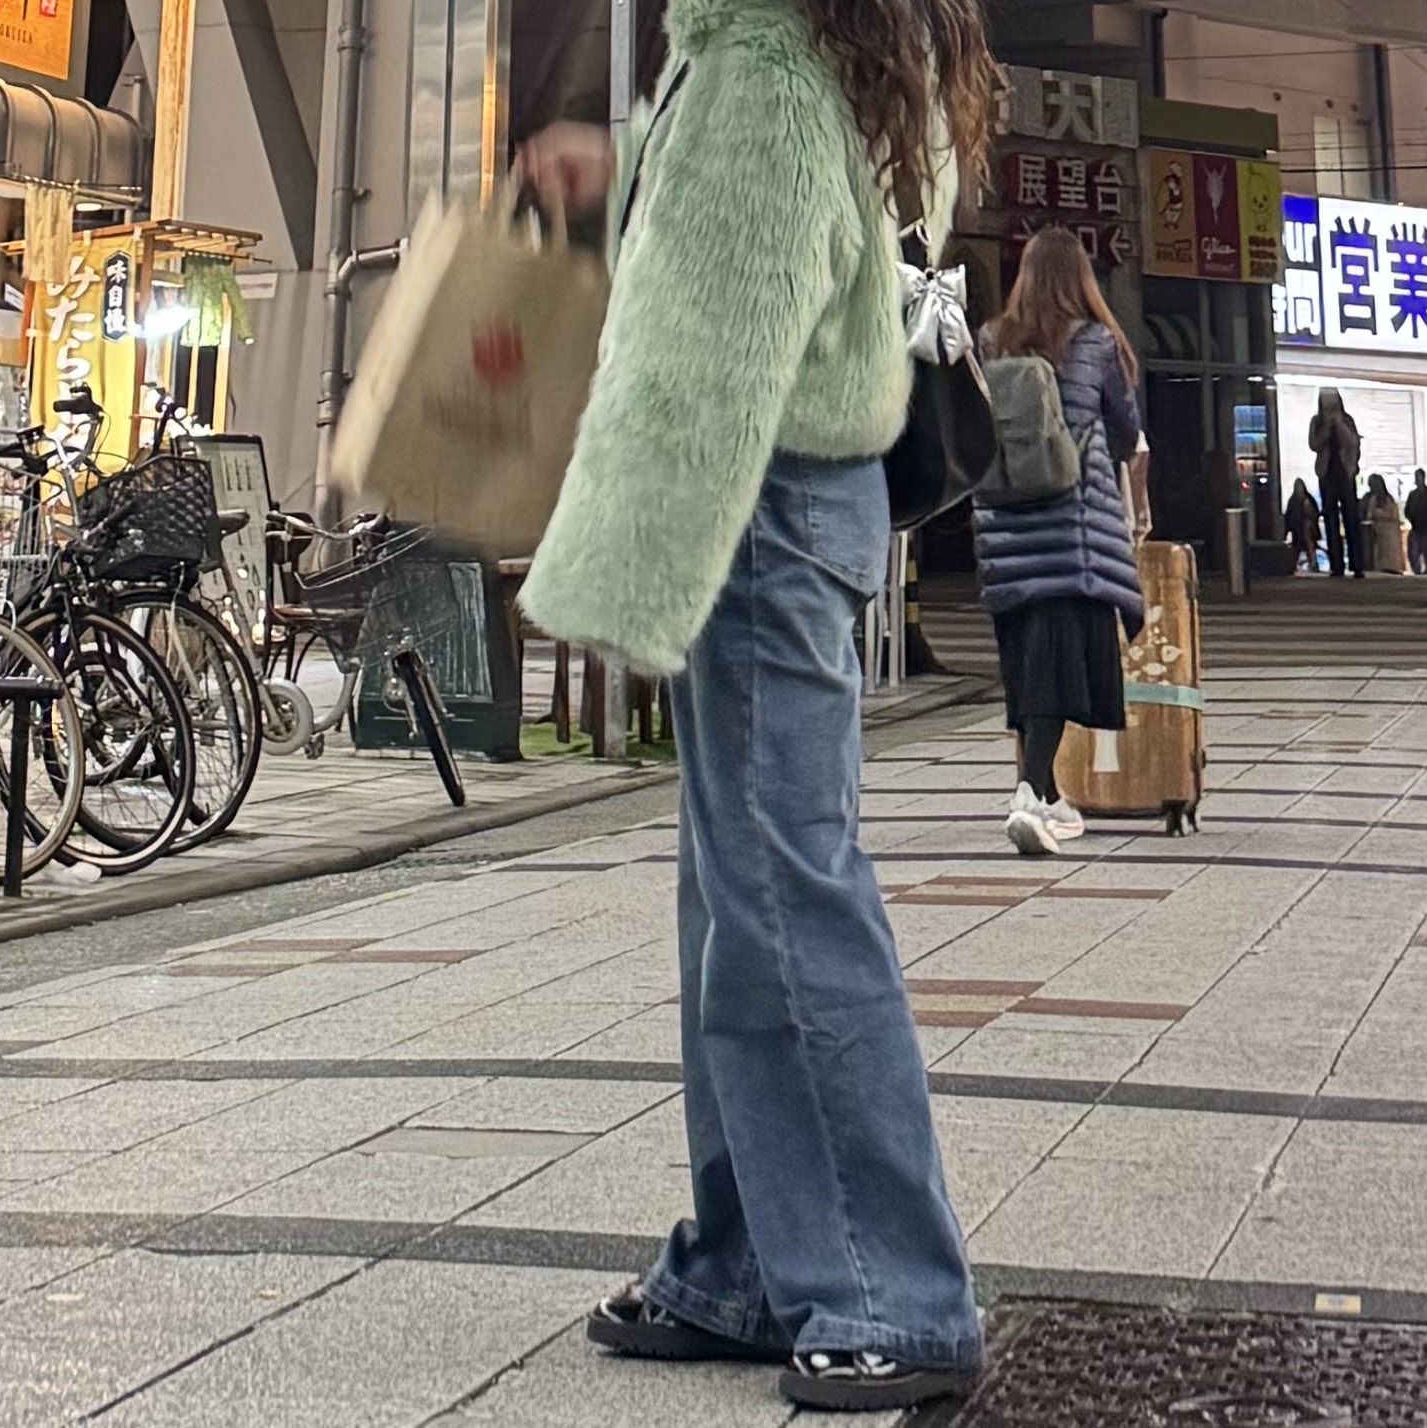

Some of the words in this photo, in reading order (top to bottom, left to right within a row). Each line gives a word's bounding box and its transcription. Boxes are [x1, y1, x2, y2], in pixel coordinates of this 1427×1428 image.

[1017, 154, 1122, 214] 展望台
[104, 259, 128, 334] 味自慢
